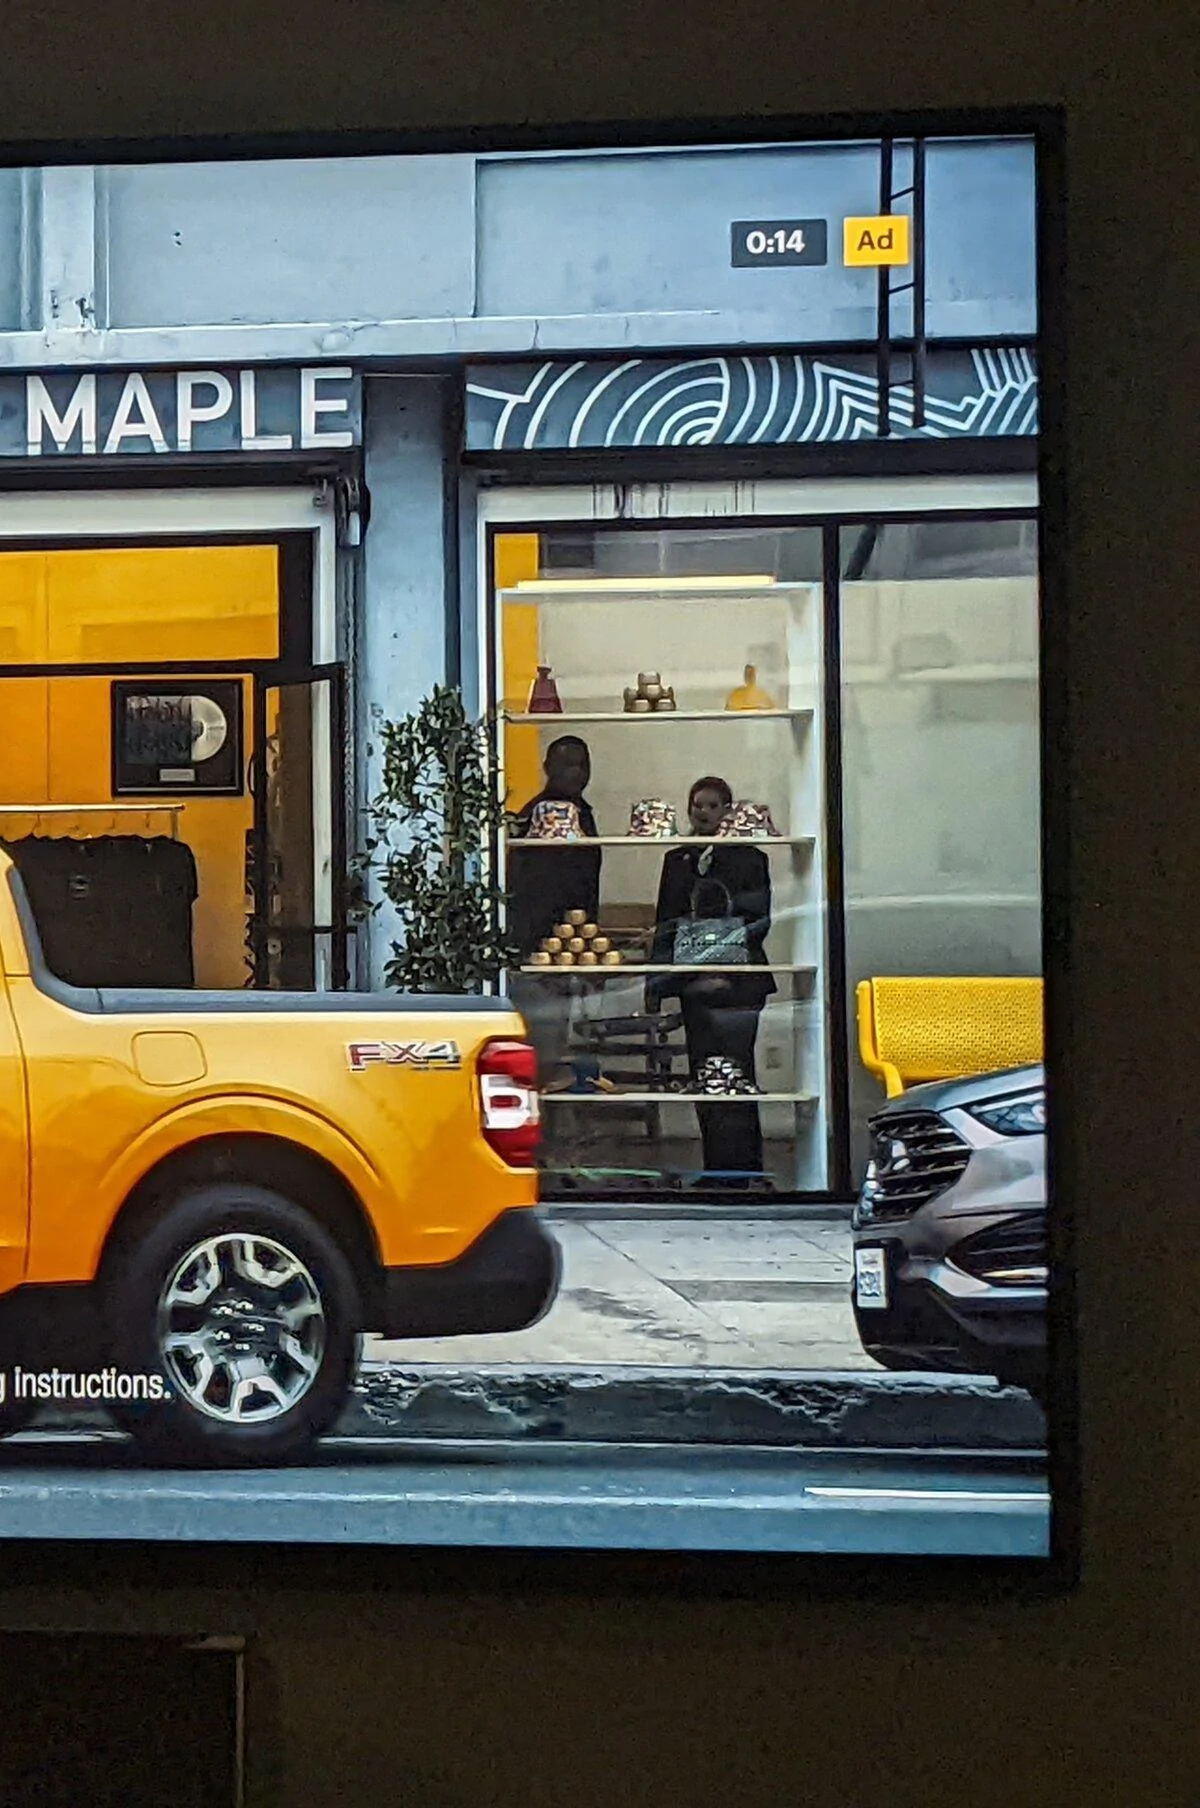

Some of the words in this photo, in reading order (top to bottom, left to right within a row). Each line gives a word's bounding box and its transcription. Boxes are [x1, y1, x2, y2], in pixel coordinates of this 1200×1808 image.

[746, 229, 806, 254] 0:14
[857, 228, 894, 251] Ad
[25, 367, 355, 455] MAPLE
[347, 1040, 462, 1071] FX4
[13, 1365, 172, 1399] instructions.
